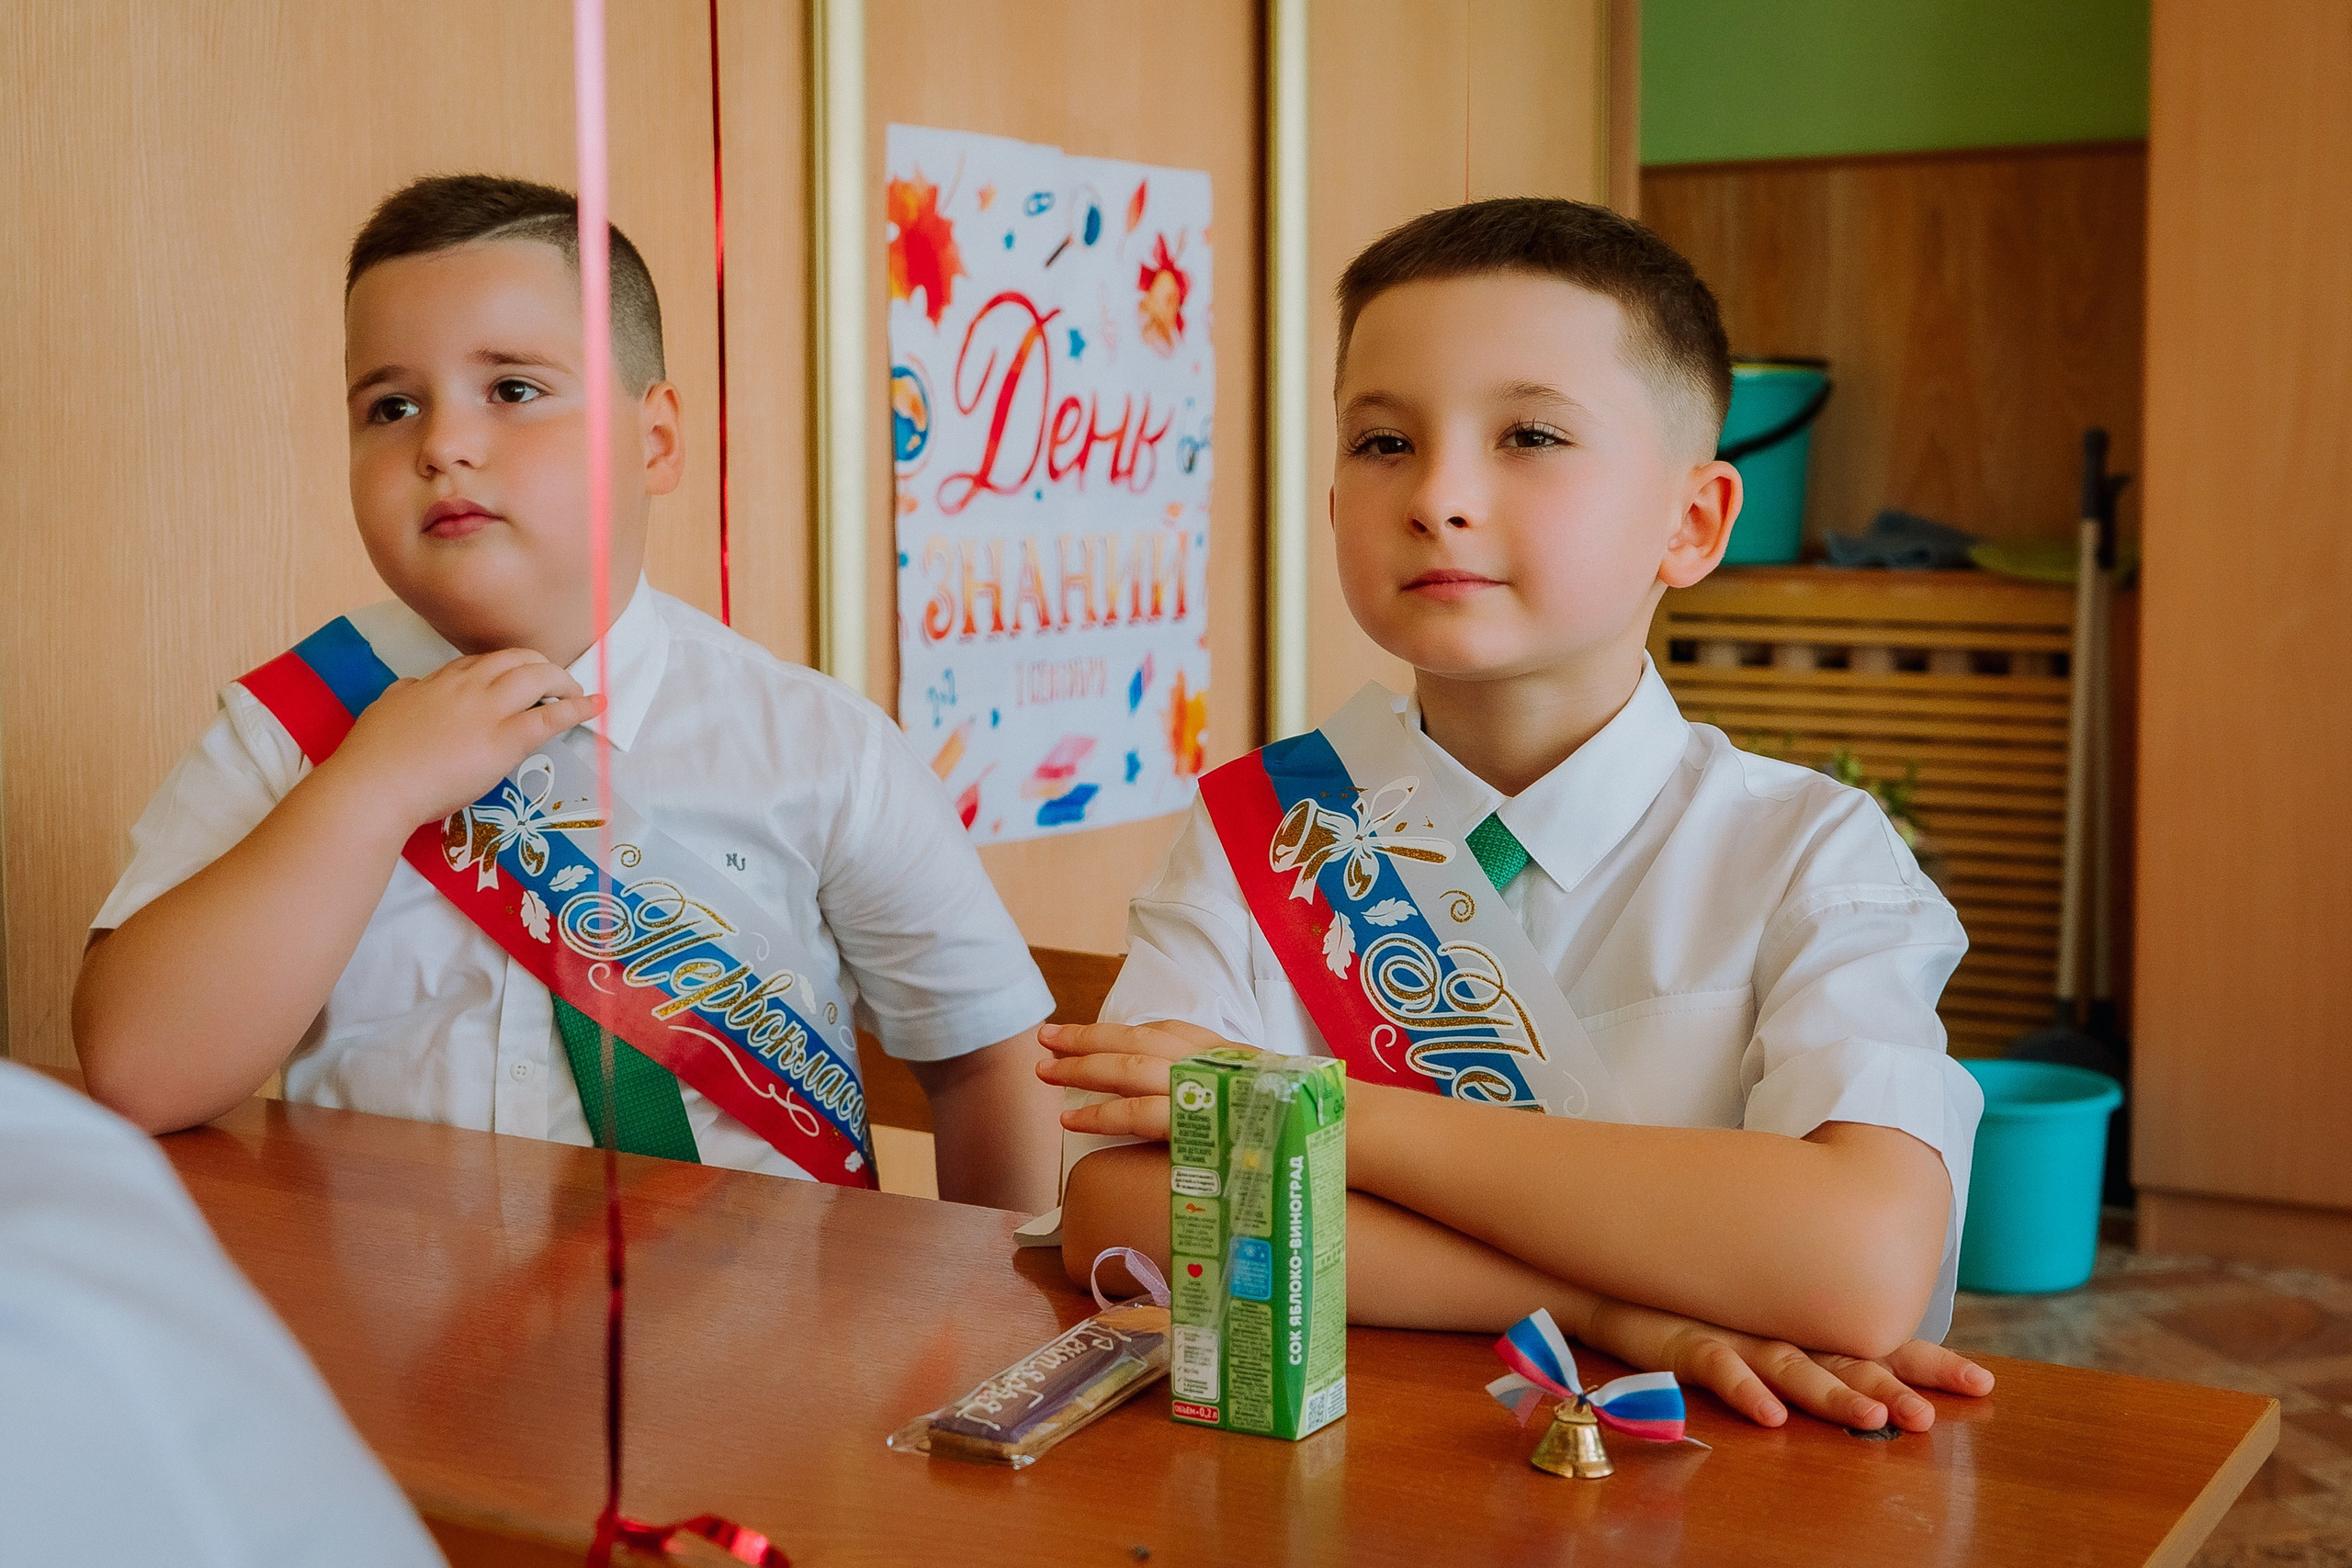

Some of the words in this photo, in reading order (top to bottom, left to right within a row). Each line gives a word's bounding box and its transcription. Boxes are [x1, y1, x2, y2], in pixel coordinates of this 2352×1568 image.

[935, 290, 1175, 514] День
[921, 502, 1191, 647] ЗНАНИЙ
[1288, 1155, 1305, 1327] ЯБЛОКО-ВИНОГРАД
[1288, 1329, 1303, 1366] СОК
